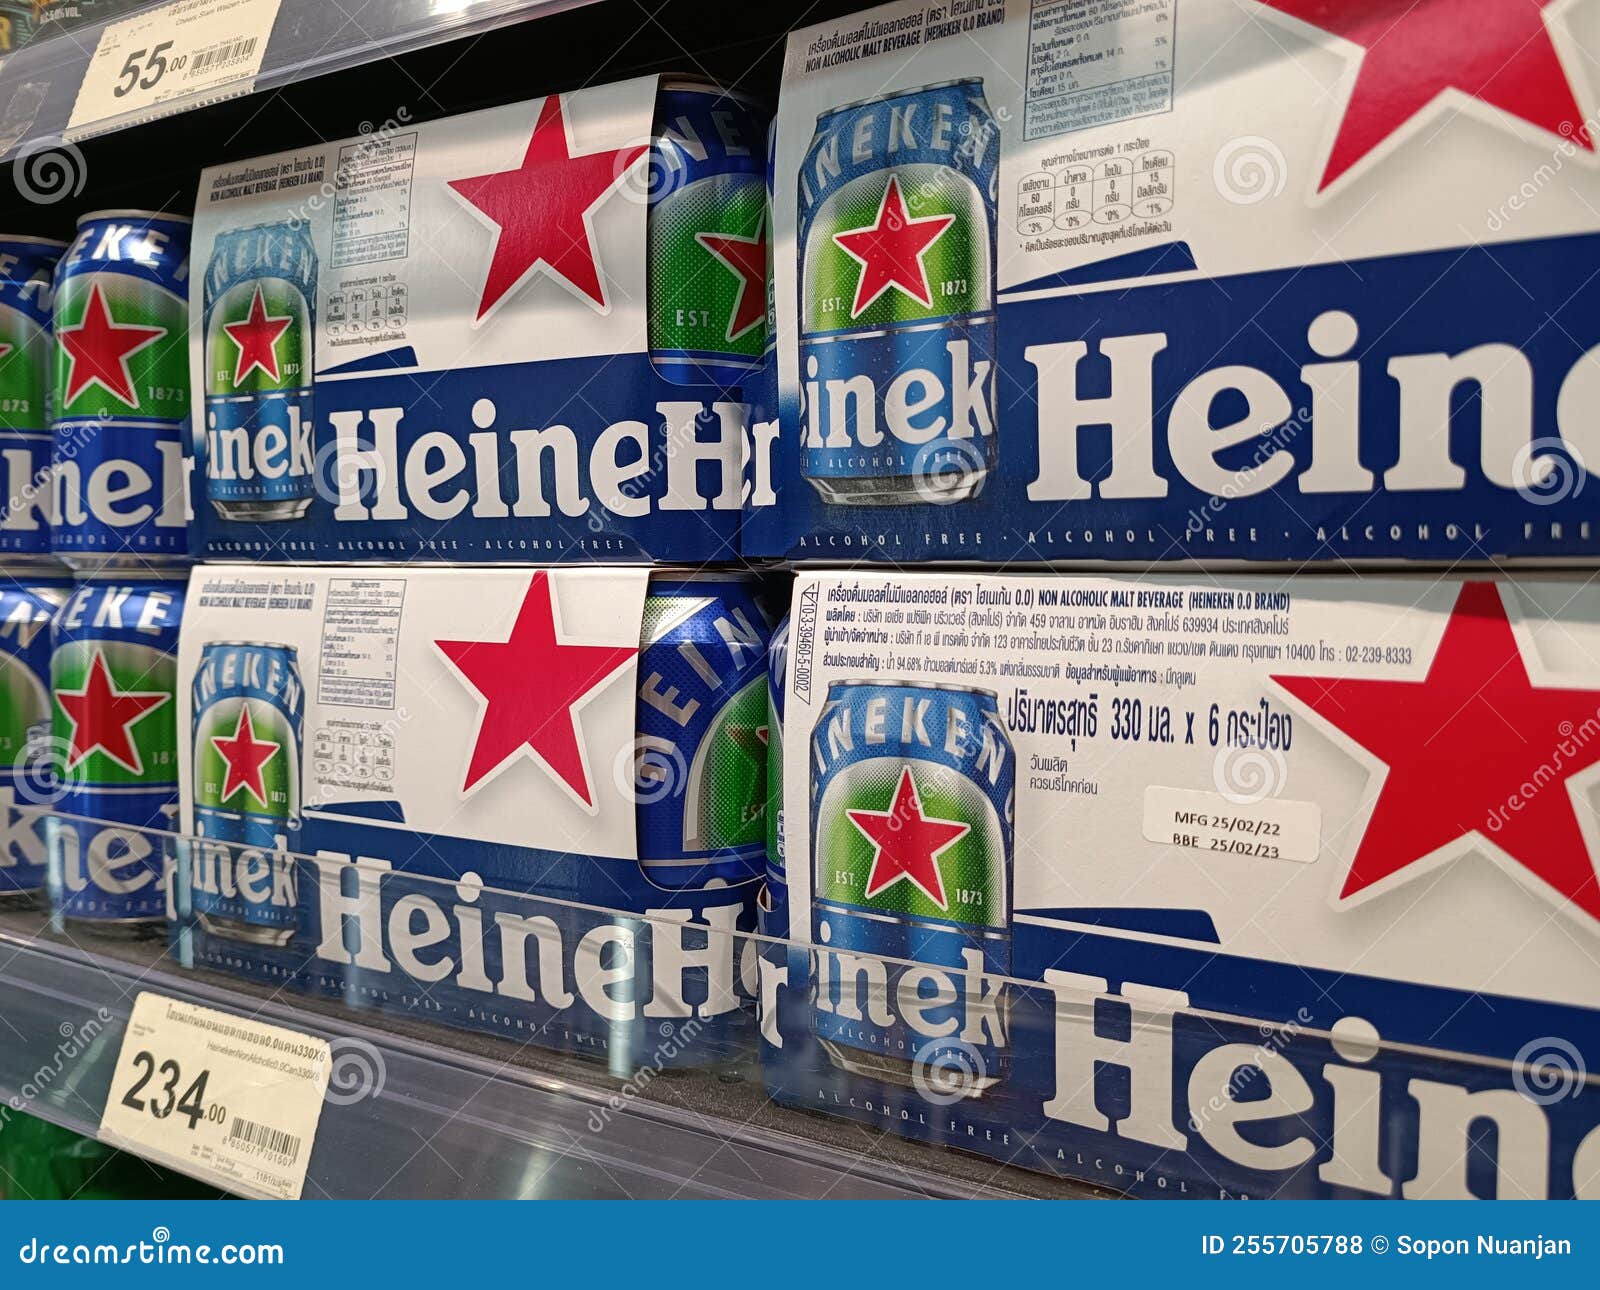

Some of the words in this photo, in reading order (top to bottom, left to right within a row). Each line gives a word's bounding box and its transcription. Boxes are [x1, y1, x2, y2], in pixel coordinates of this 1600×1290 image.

[805, 57, 821, 73] NON
[822, 46, 861, 68] ALCOHOLIC
[861, 42, 881, 59] MALT
[882, 32, 920, 54] BEVERAGE
[976, 7, 1006, 29] BRAND)
[940, 280, 967, 296] 1873
[800, 340, 997, 448] inek
[485, 539, 564, 550] ALCOHOL
[800, 533, 901, 547] ALCOHOL
[925, 532, 982, 545] FREE
[1028, 529, 1156, 544] ALCOHOL
[1186, 527, 1259, 542] FREE
[1316, 522, 1486, 540] ALCOHOL
[951, 587, 972, 608] (ตรา
[976, 583, 1012, 606] ไฮเนเก้น
[1015, 588, 1035, 609] 0.0)
[1038, 589, 1057, 607] NON
[1060, 589, 1108, 608] ALCOHOLIC
[1110, 590, 1135, 608] MALT
[1137, 590, 1184, 609] BEVERAGE
[1188, 591, 1235, 611] (HEINEKEN
[1237, 592, 1252, 610] 0.0
[1254, 592, 1290, 613] BRAND)
[1006, 611, 1027, 627] จำกัด
[1030, 613, 1047, 628] 459
[1146, 611, 1179, 632] สิงคโปร์
[1182, 616, 1218, 633] 639934
[1222, 614, 1289, 635] ประเทศสิงคโปร์
[994, 634, 1008, 649] 123
[1101, 637, 1113, 653] 23
[1285, 643, 1316, 661] 10400
[1319, 639, 1335, 662] โทร
[1345, 646, 1412, 665] 02-239-8333
[897, 656, 921, 671] 94.68%
[980, 659, 998, 675] 5.3%
[1008, 687, 1098, 751] ปริมาตรสุทธิ
[1111, 697, 1141, 741] 330
[1149, 702, 1175, 744] มล.
[1185, 711, 1194, 744] x
[1209, 702, 1219, 747] 6
[1227, 696, 1292, 751] กระป๋อง
[1030, 755, 1068, 773] วันผลิต
[1030, 774, 1098, 795] ควรบริโภคก่อน
[1175, 811, 1208, 827] MFG
[1211, 815, 1281, 837] 25/02/22
[1172, 833, 1200, 848] BBE
[1210, 838, 1280, 859] 25/02/23
[956, 888, 983, 905] 1873
[809, 921, 1009, 1047] inek
[121, 1051, 226, 1130] 234.00
[1043, 968, 1600, 1200] Hein
[819, 1089, 926, 1125] ALCOHOL
[951, 1121, 1009, 1145] FREE
[1057, 1148, 1188, 1193] ALCOHOL
